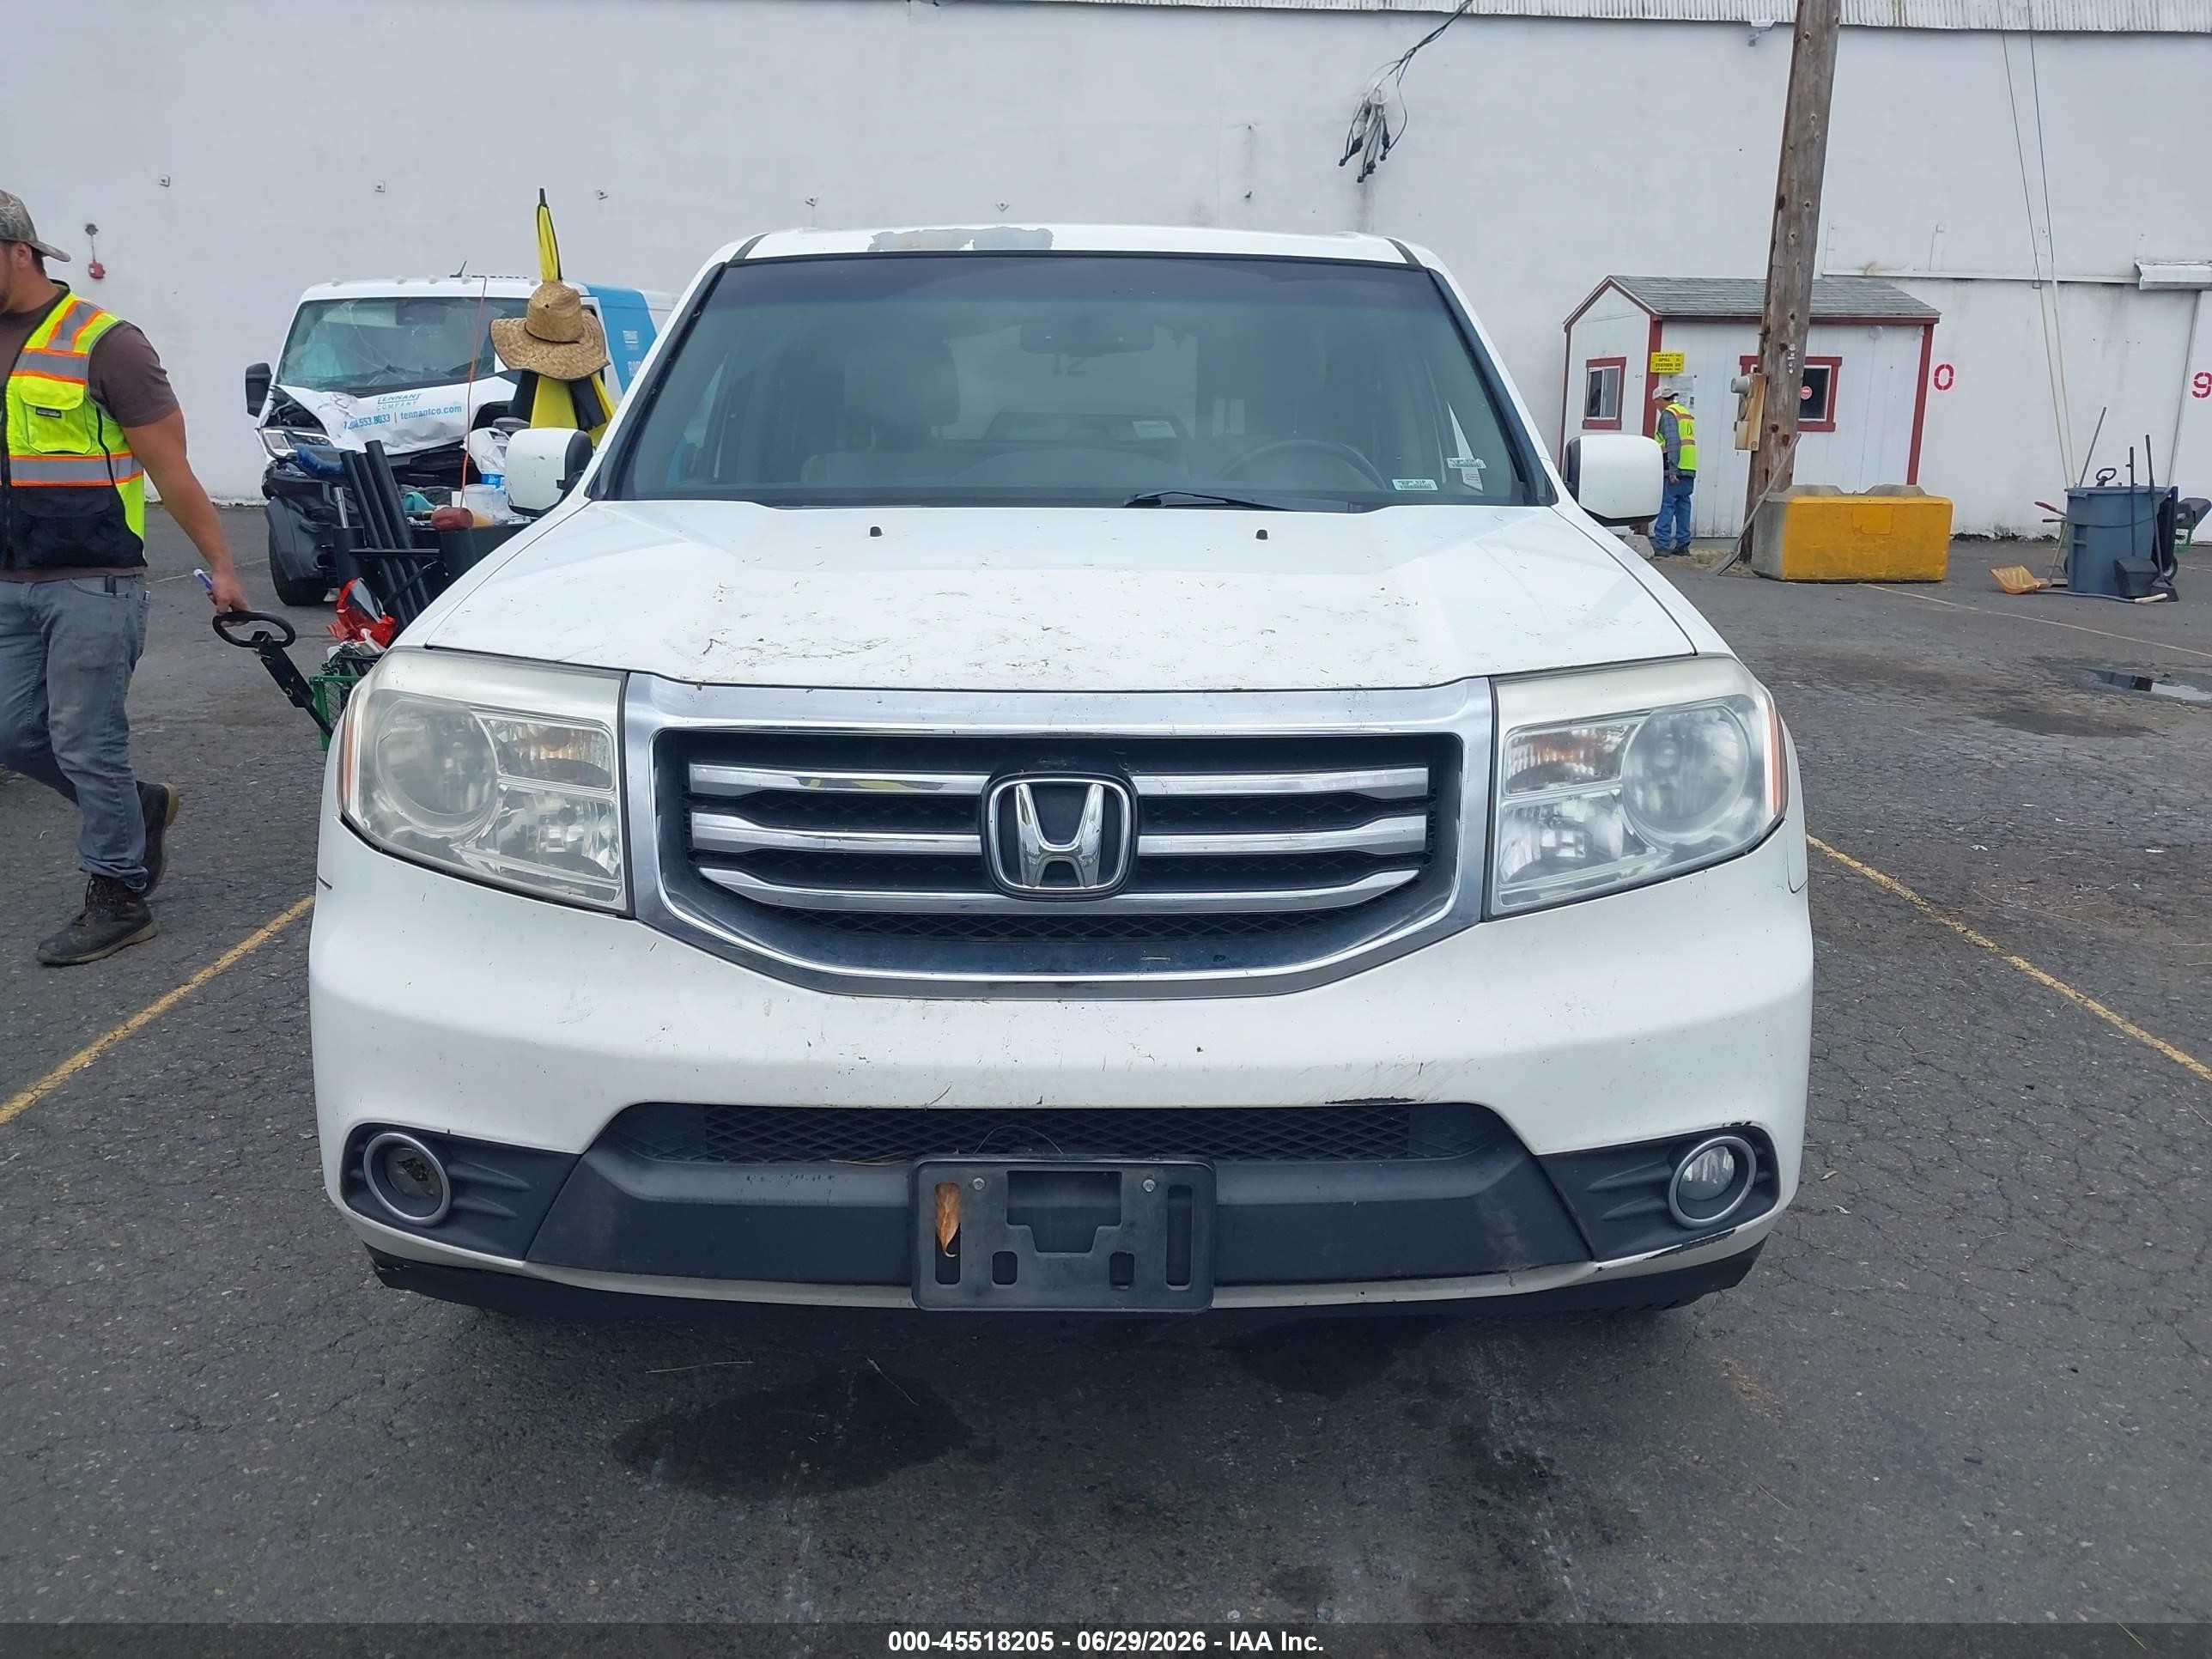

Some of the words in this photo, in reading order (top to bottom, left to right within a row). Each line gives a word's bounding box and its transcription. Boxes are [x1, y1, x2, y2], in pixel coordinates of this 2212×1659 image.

[1934, 363, 1954, 391] 0
[2191, 371, 2212, 398] 9
[377, 401, 417, 410] COMPANY
[378, 392, 423, 404] TENNANT
[400, 405, 462, 420] tennantco.com
